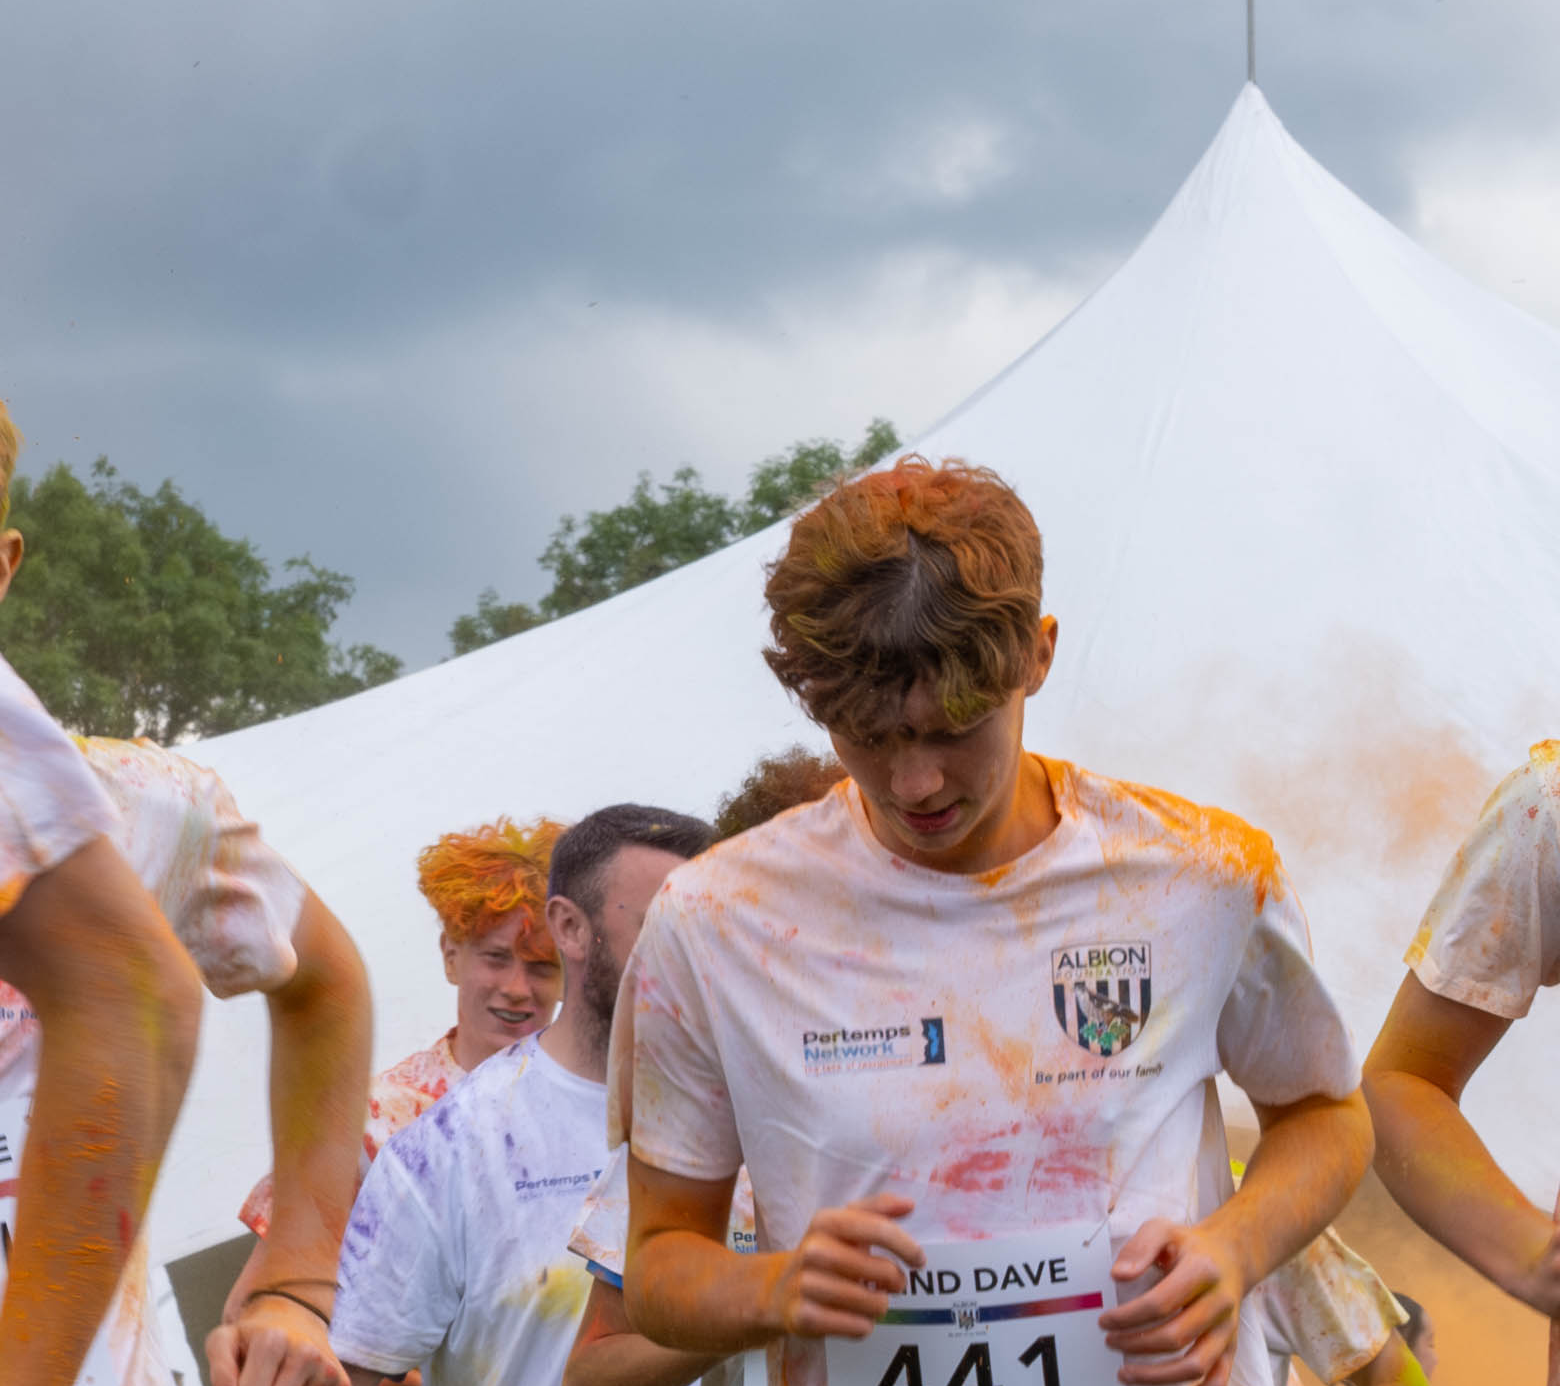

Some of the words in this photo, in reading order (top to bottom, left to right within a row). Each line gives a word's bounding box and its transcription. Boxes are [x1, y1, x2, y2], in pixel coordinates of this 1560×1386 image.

[1058, 946, 1146, 970] ALBION
[802, 1027, 912, 1045] Pertemps
[803, 1041, 894, 1061] Network
[1035, 1071, 1053, 1085] Be
[1058, 1069, 1086, 1086] part
[1091, 1066, 1106, 1080] of
[1109, 1069, 1131, 1079] our
[514, 1173, 591, 1192] Pertemps
[974, 1258, 1069, 1293] DAVE
